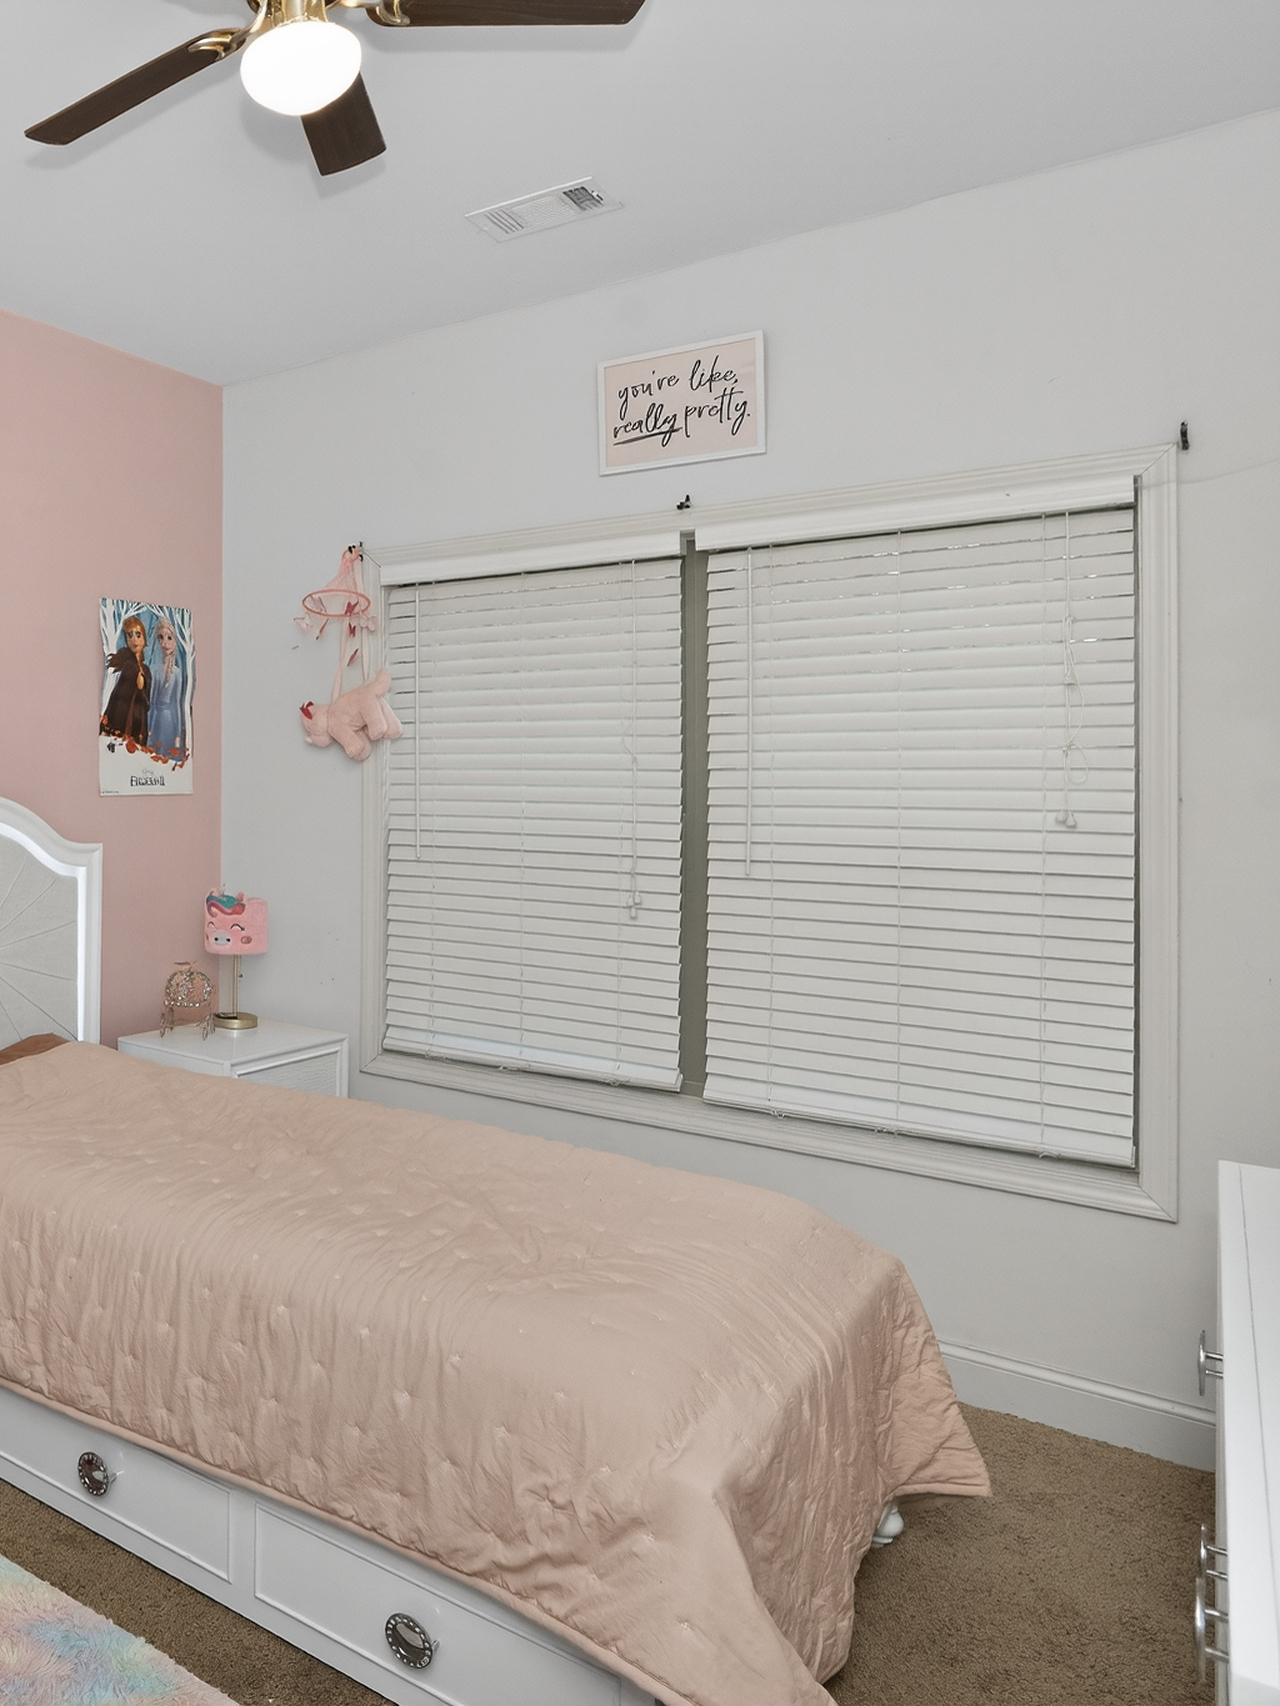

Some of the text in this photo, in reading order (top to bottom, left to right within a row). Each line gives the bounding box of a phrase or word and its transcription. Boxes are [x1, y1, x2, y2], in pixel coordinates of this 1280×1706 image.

[613, 387, 751, 447] really pretty.
[617, 354, 739, 421] you're like,
